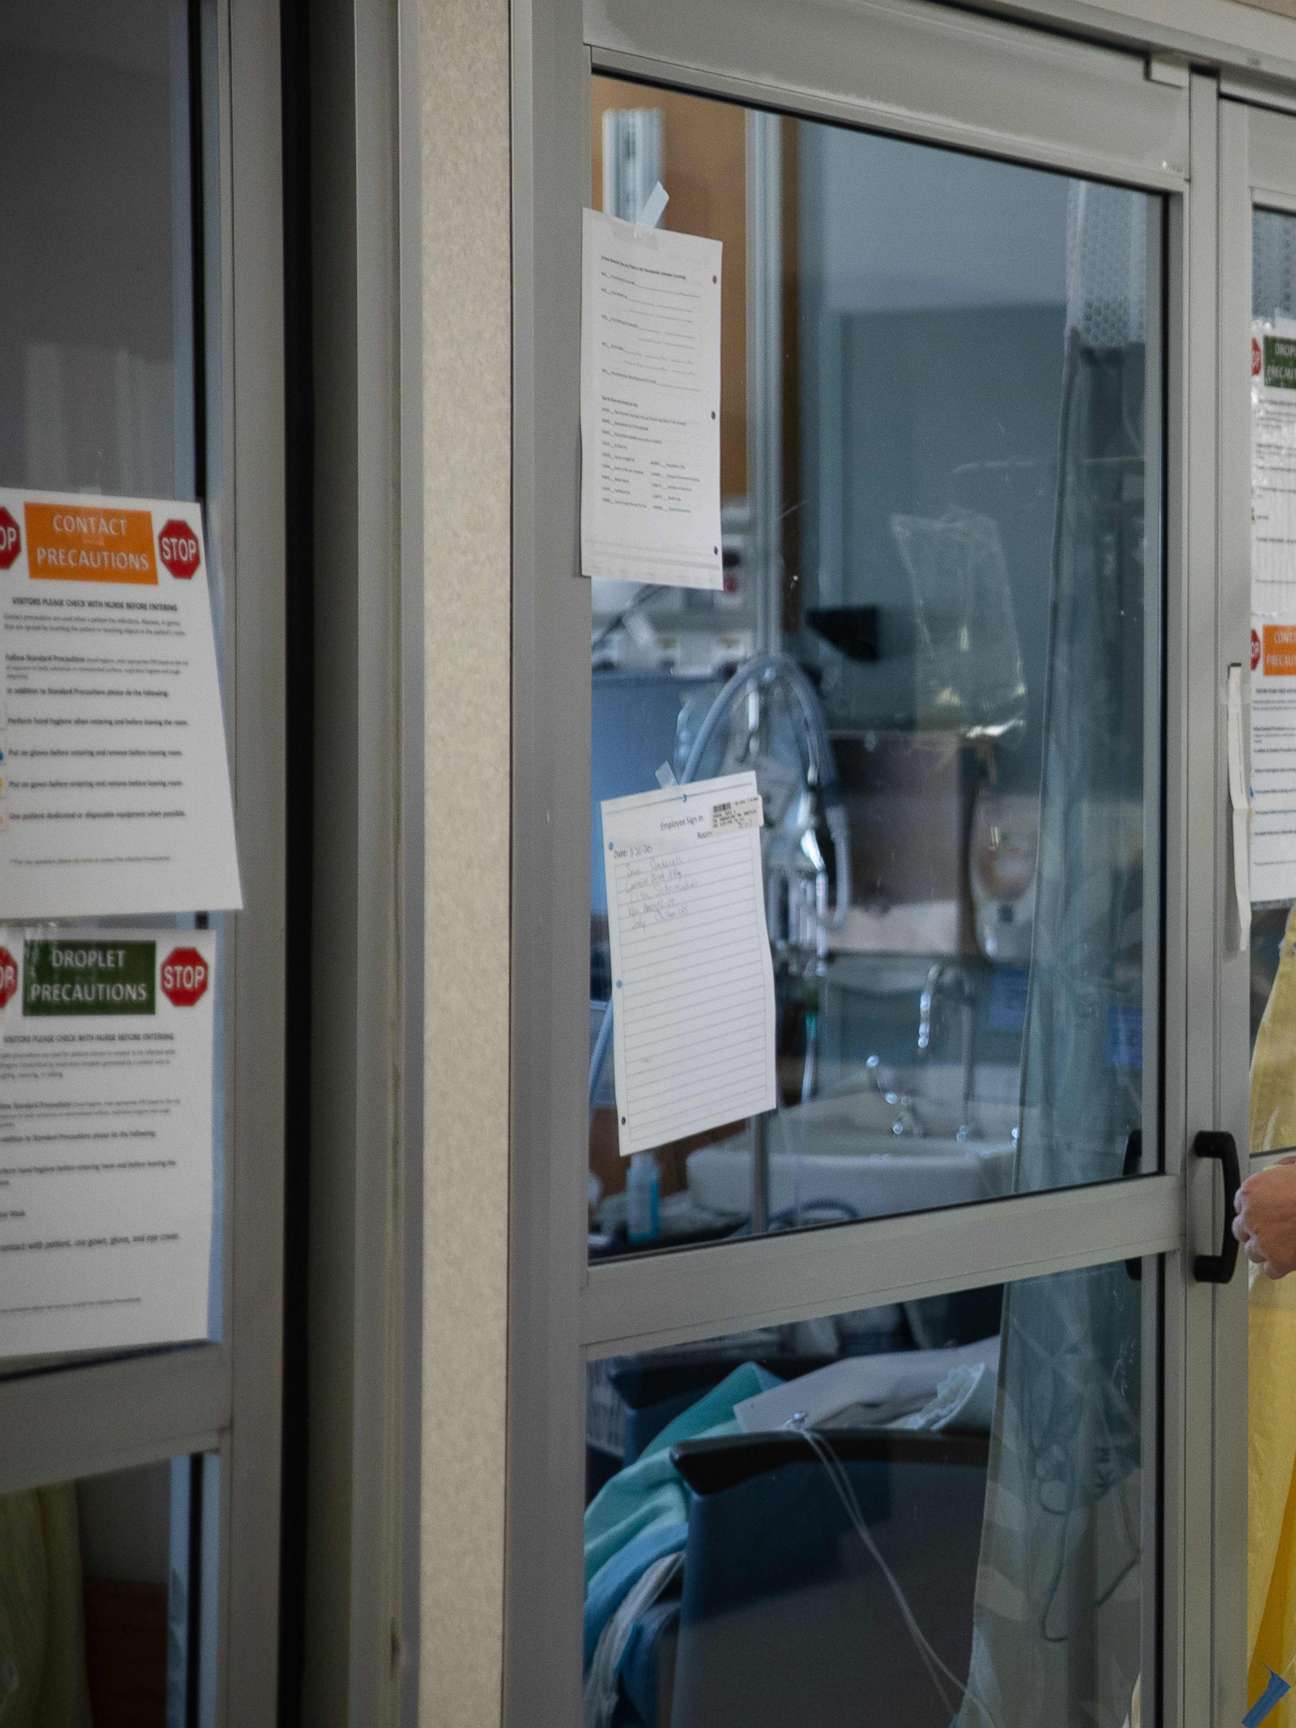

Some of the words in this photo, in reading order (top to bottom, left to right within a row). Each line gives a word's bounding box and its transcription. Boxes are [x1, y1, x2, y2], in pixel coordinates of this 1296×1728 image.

[53, 513, 128, 536] CONTACT
[37, 547, 149, 570] PRECAUTIONS
[161, 538, 197, 561] STOP
[51, 949, 127, 968] DROPLET
[163, 965, 206, 989] STOP
[31, 983, 147, 1001] PRECAUTIONS
